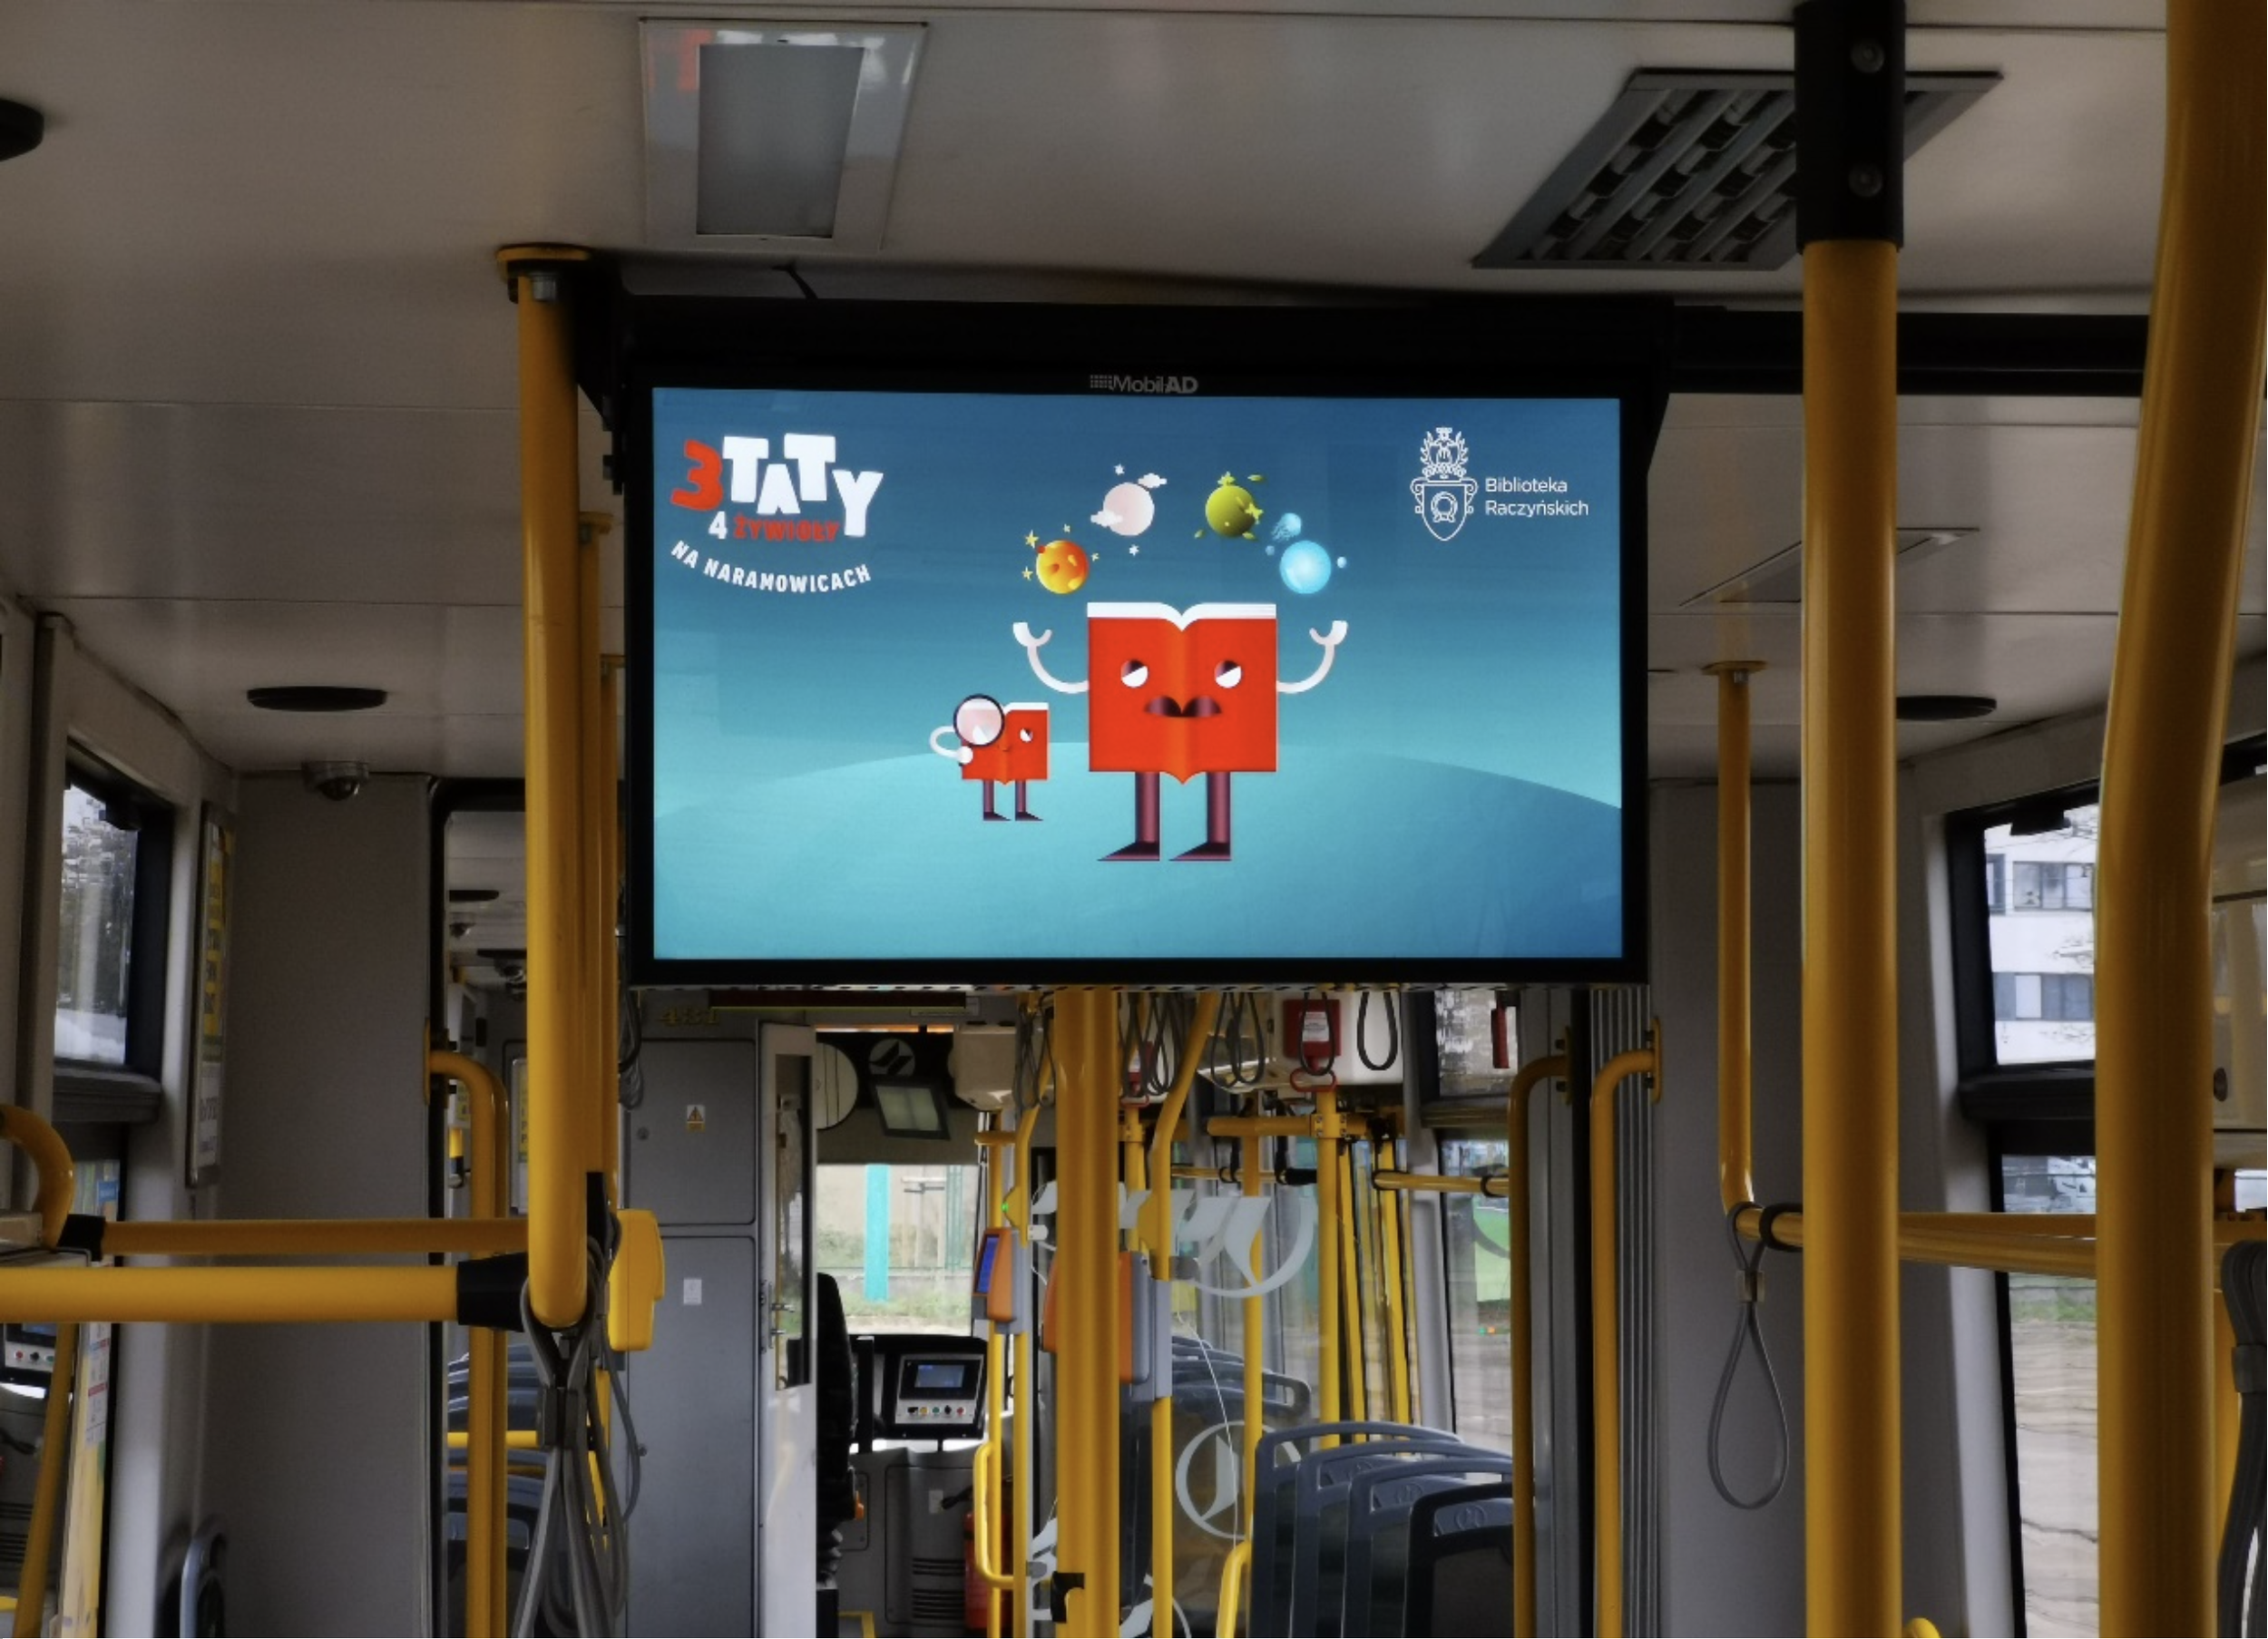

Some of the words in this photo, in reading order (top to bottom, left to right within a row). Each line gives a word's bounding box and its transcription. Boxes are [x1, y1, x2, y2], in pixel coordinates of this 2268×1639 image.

[1484, 476, 1569, 493] Biblioteka
[1484, 500, 1589, 518] Raczyńskich
[708, 510, 728, 541] 4
[734, 512, 840, 542] ŻYWIOŁY
[670, 540, 699, 569] NA
[703, 558, 872, 593] NARAMOWICACH
